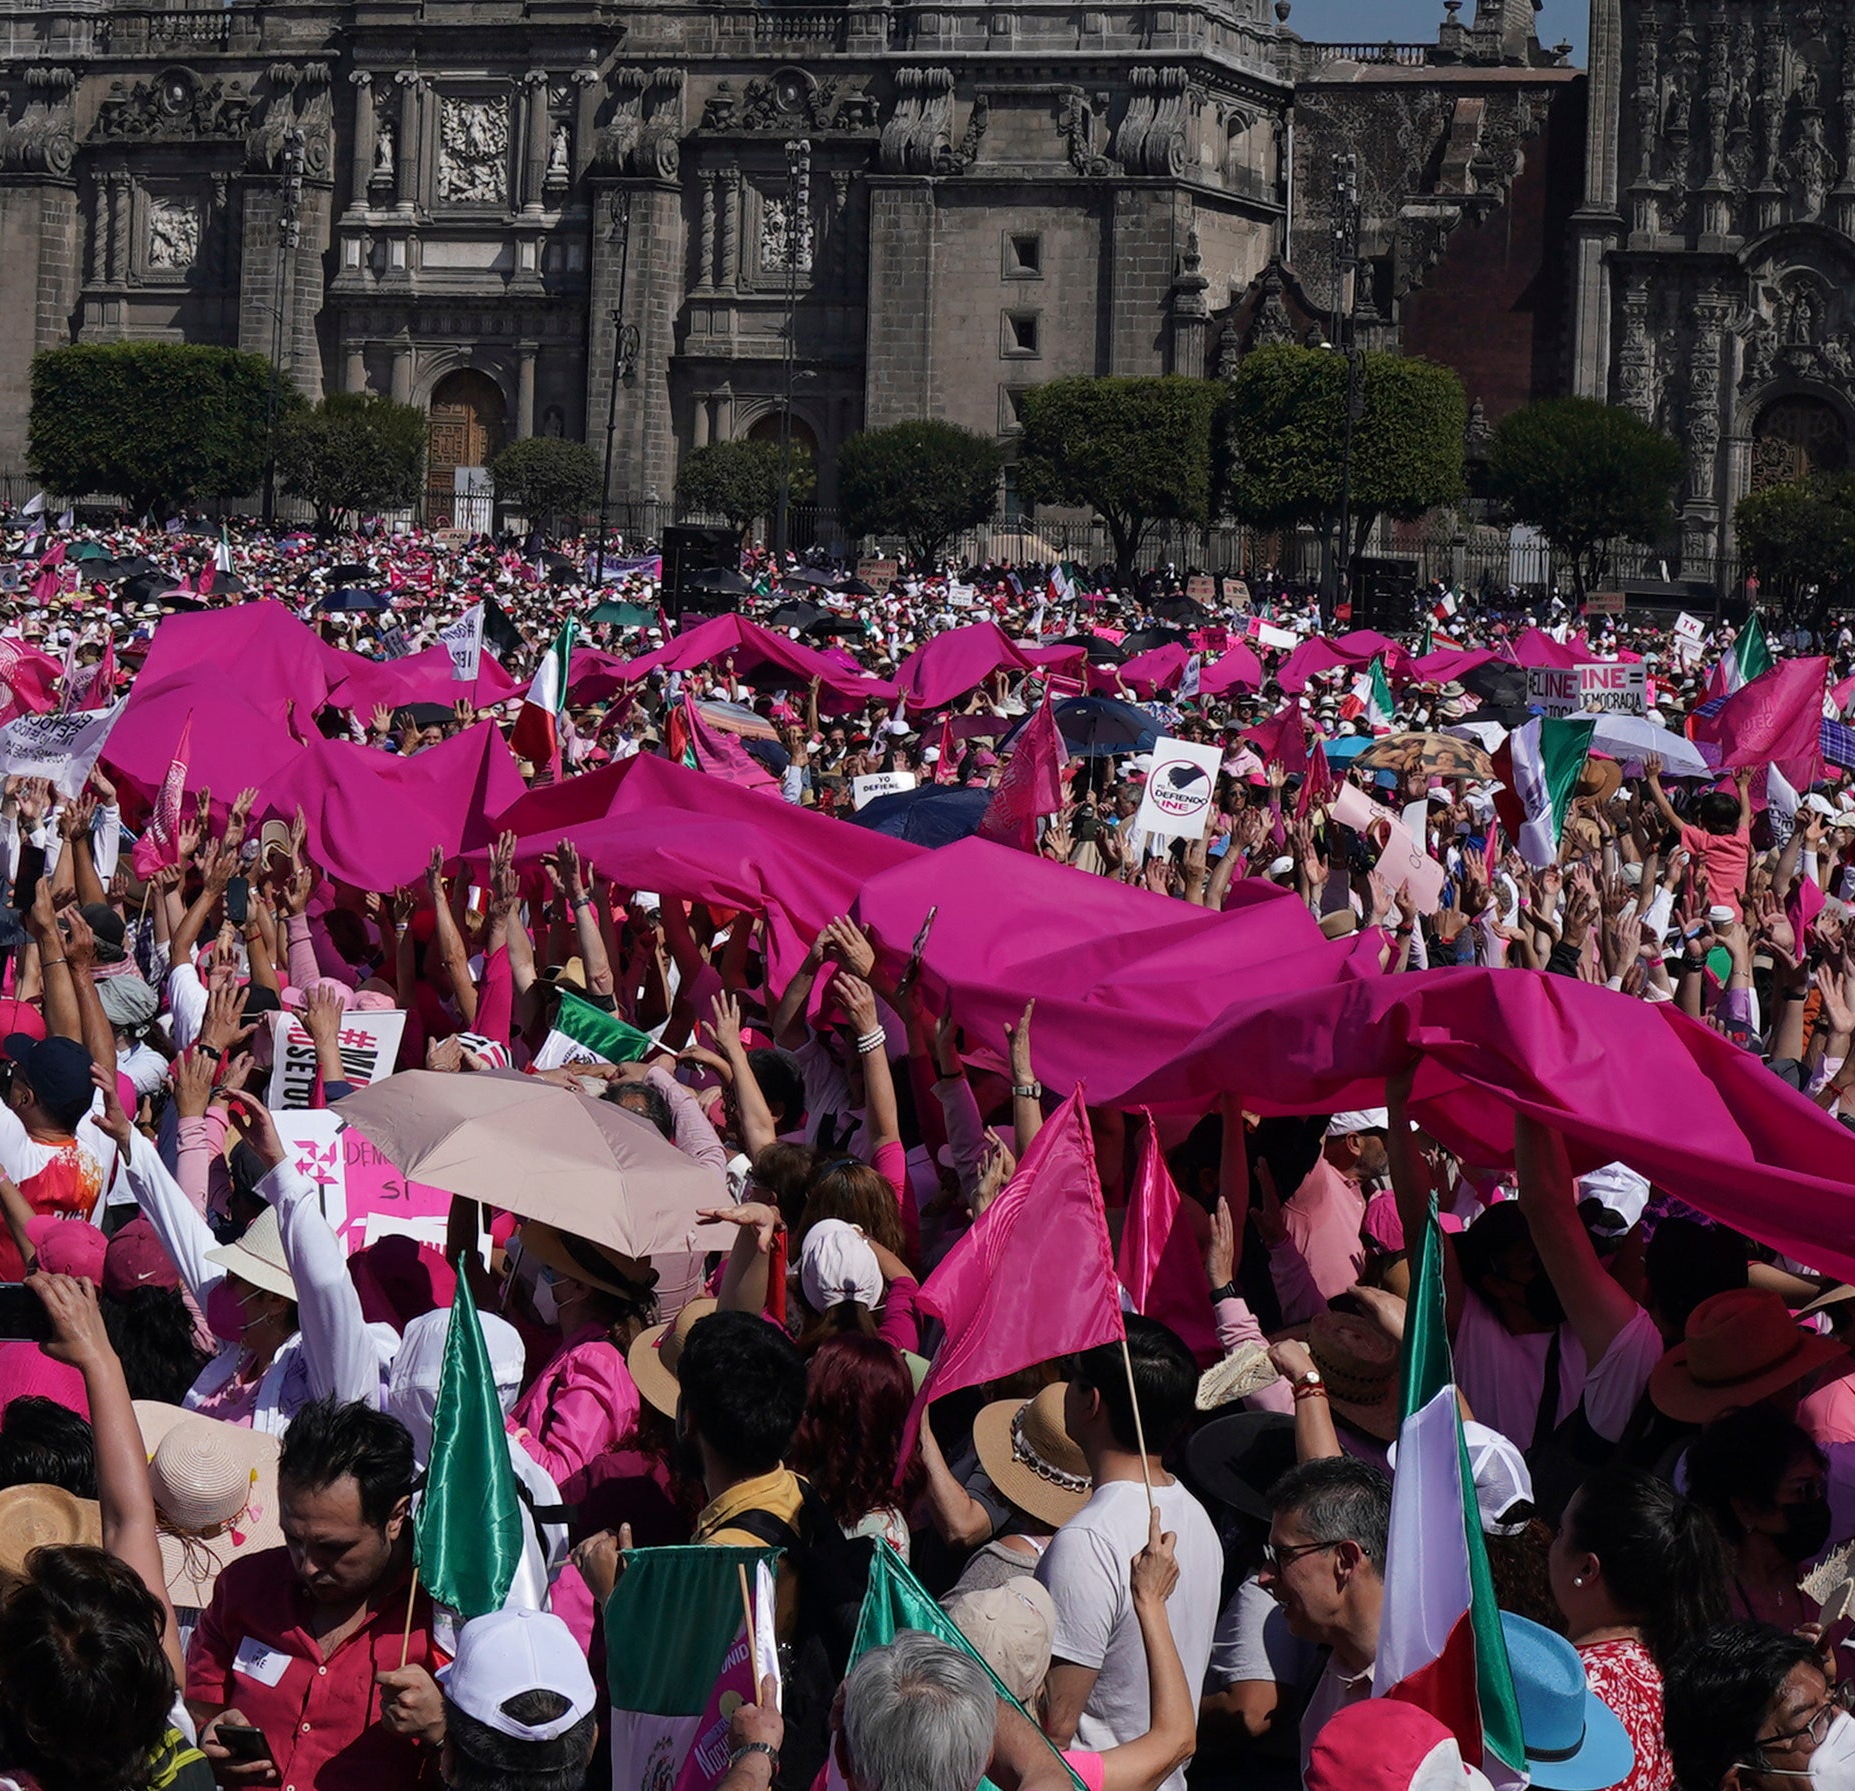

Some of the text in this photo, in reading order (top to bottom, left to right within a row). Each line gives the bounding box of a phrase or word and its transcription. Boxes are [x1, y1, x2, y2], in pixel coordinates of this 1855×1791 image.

[1581, 667, 1626, 693] INE
[1579, 692, 1642, 710] DEMOCRACIA
[878, 775, 891, 784] YO
[1154, 789, 1209, 806] DEFIENDO
[1161, 799, 1189, 812] INE
